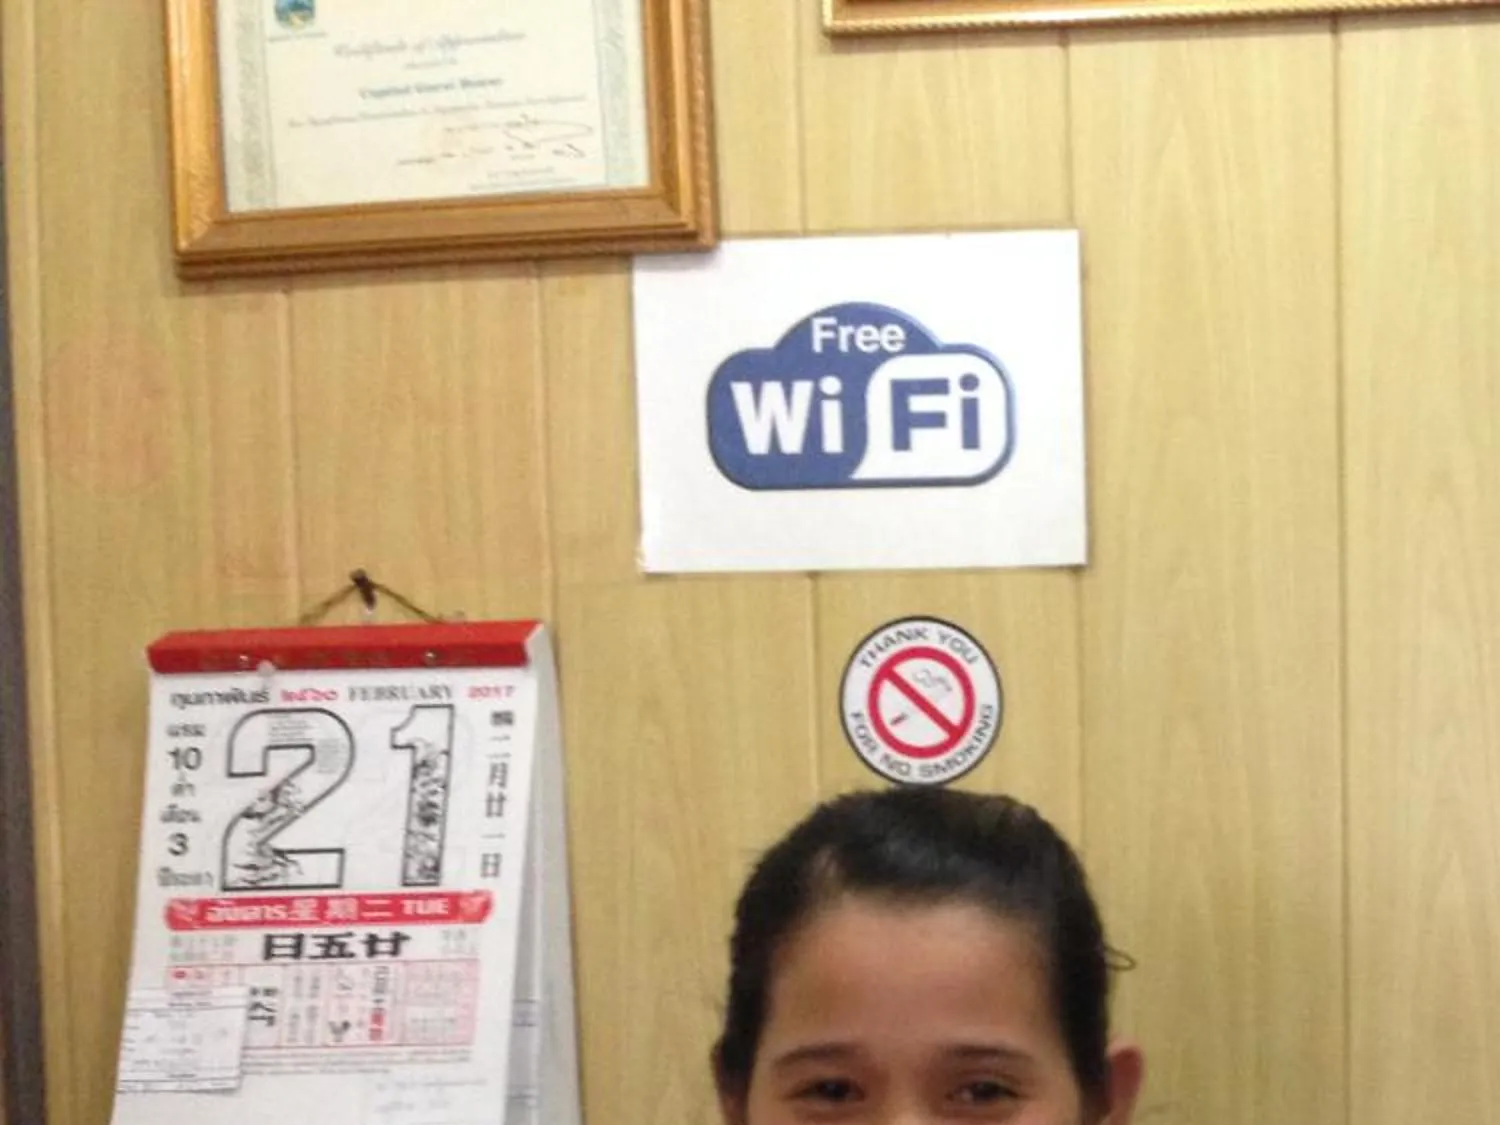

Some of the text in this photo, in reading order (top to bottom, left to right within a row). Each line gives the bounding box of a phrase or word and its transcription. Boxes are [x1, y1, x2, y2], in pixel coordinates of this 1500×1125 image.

[811, 316, 907, 354] Free
[859, 627, 980, 668] THANK YOU
[348, 684, 454, 701] FEBRUARY
[849, 703, 994, 778] FOR NO SMOKING
[167, 746, 203, 771] 10
[167, 832, 189, 857] 3
[403, 897, 450, 916] TUE
